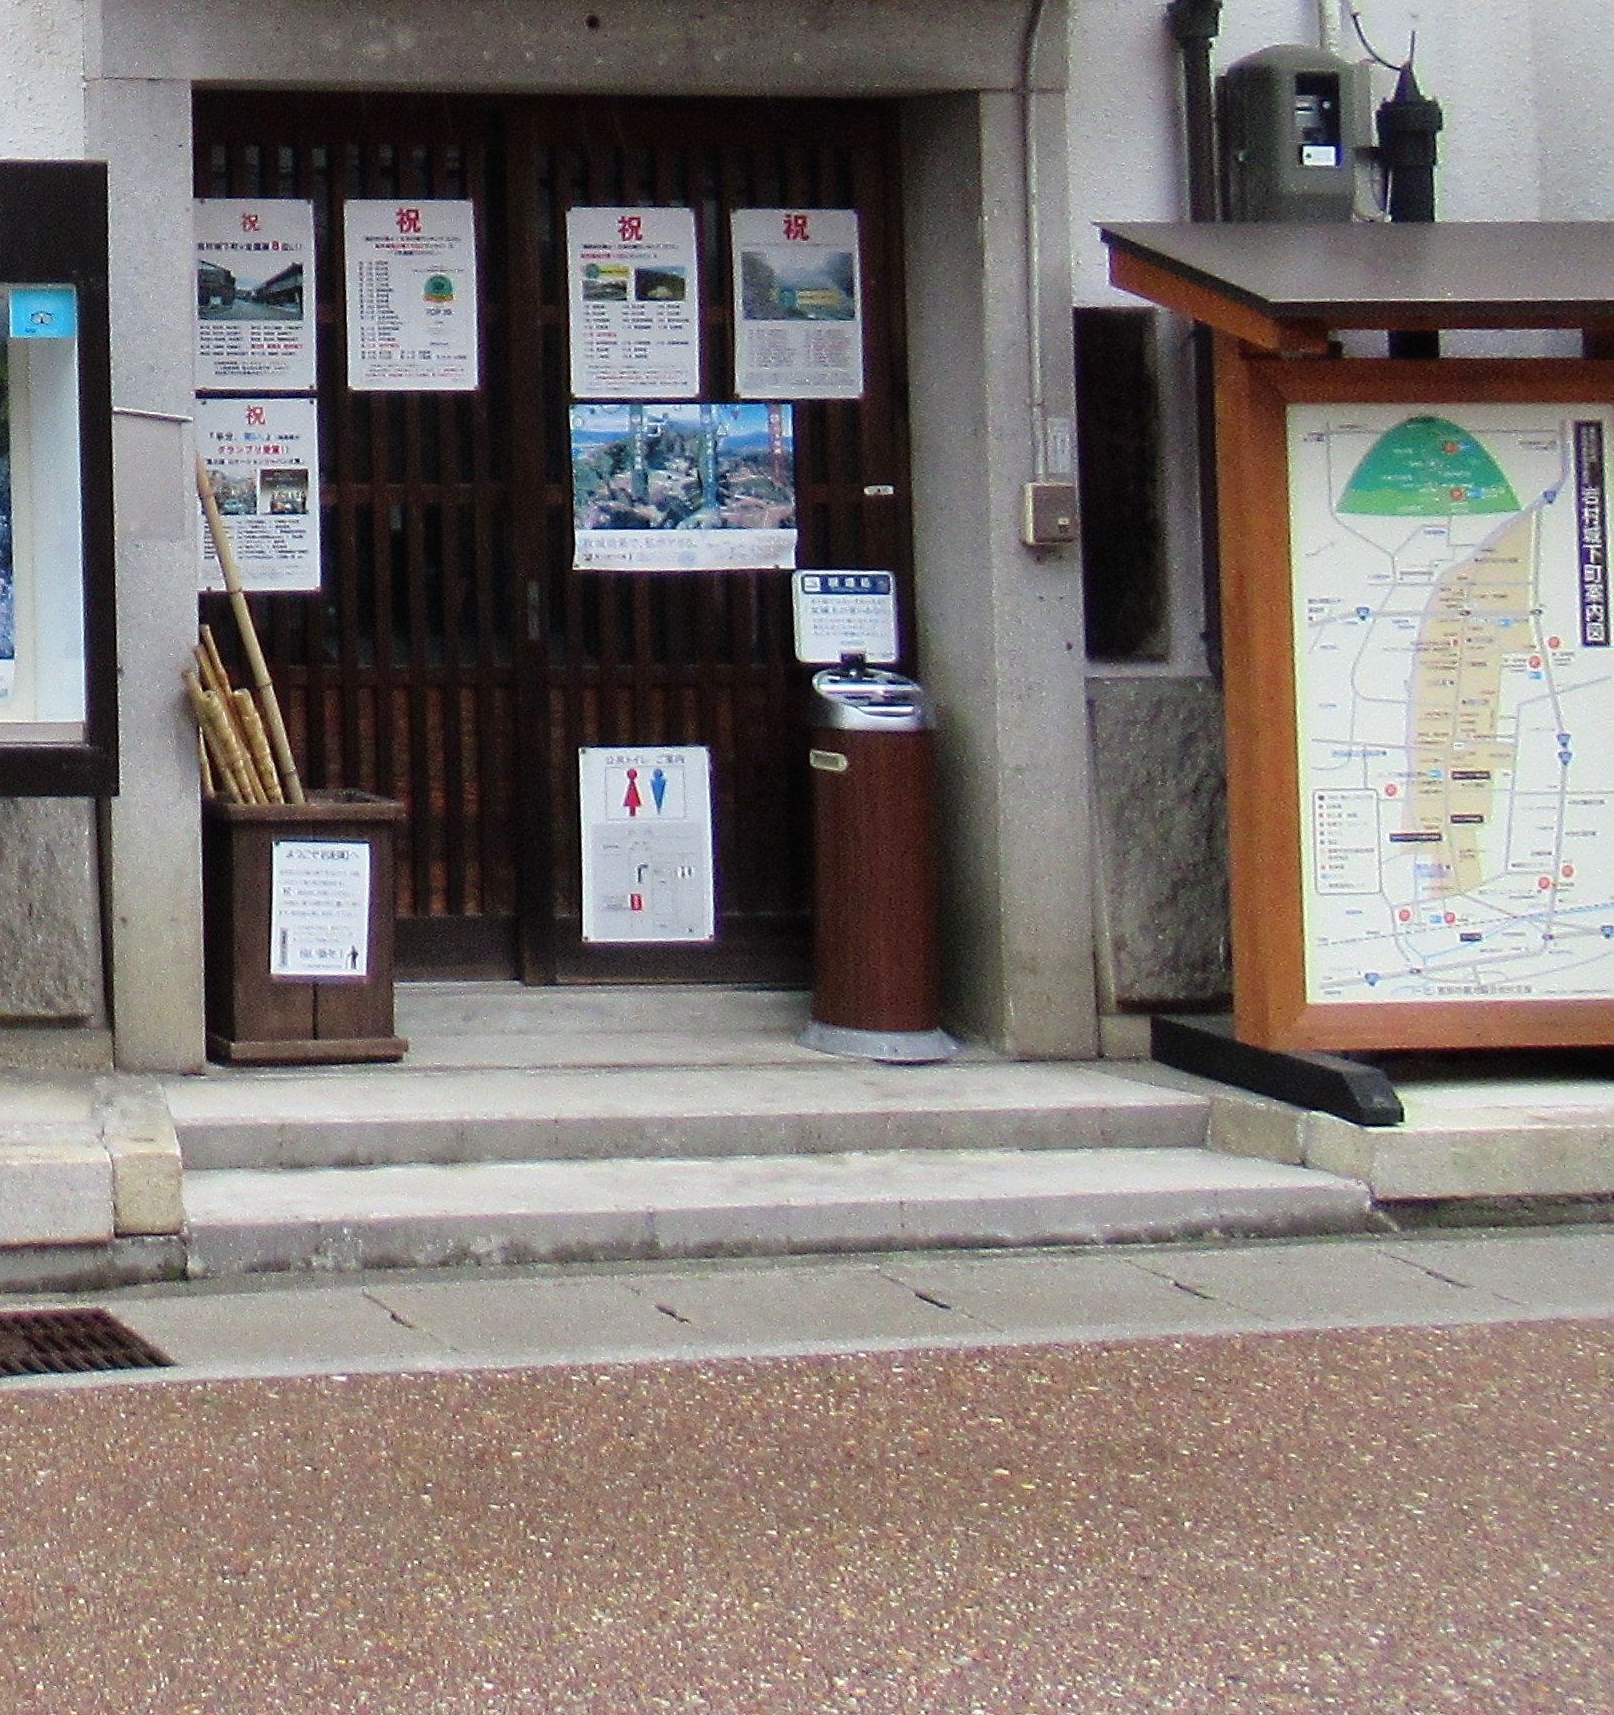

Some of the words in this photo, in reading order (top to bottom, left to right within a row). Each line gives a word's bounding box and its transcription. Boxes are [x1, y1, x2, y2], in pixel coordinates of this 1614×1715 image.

[241, 213, 262, 233] 祝
[396, 208, 422, 234] 祝
[617, 215, 643, 242] 祝
[783, 213, 811, 242] 祝
[246, 404, 267, 426] 祝
